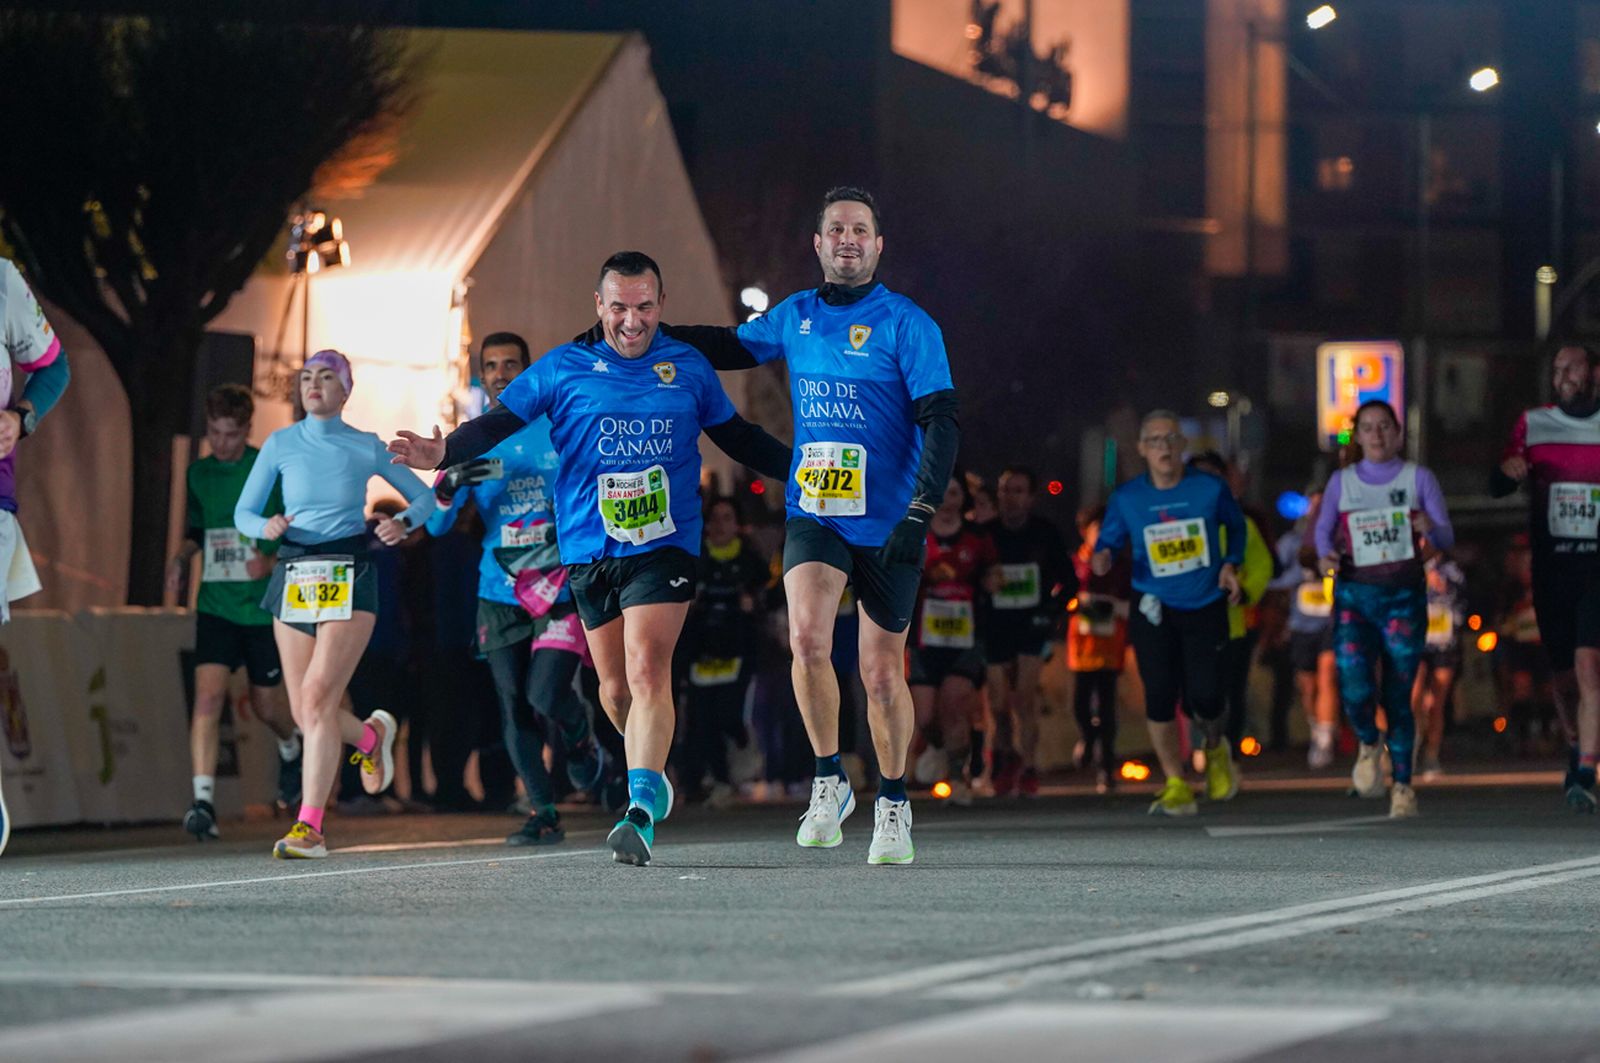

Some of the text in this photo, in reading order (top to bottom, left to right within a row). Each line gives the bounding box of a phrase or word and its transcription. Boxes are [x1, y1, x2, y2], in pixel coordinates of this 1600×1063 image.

[799, 378, 858, 399] ORO DE
[800, 396, 866, 421] CÁNAVA
[599, 417, 674, 435] ORO DE
[598, 435, 673, 456] CÁNAVA
[507, 475, 545, 492] ADRA
[510, 489, 547, 503] TRAIL
[607, 490, 623, 499] SAN
[614, 493, 659, 522] 3444
[1559, 501, 1596, 518] 3543
[1362, 528, 1399, 545] 3542
[297, 583, 340, 603] 8832
